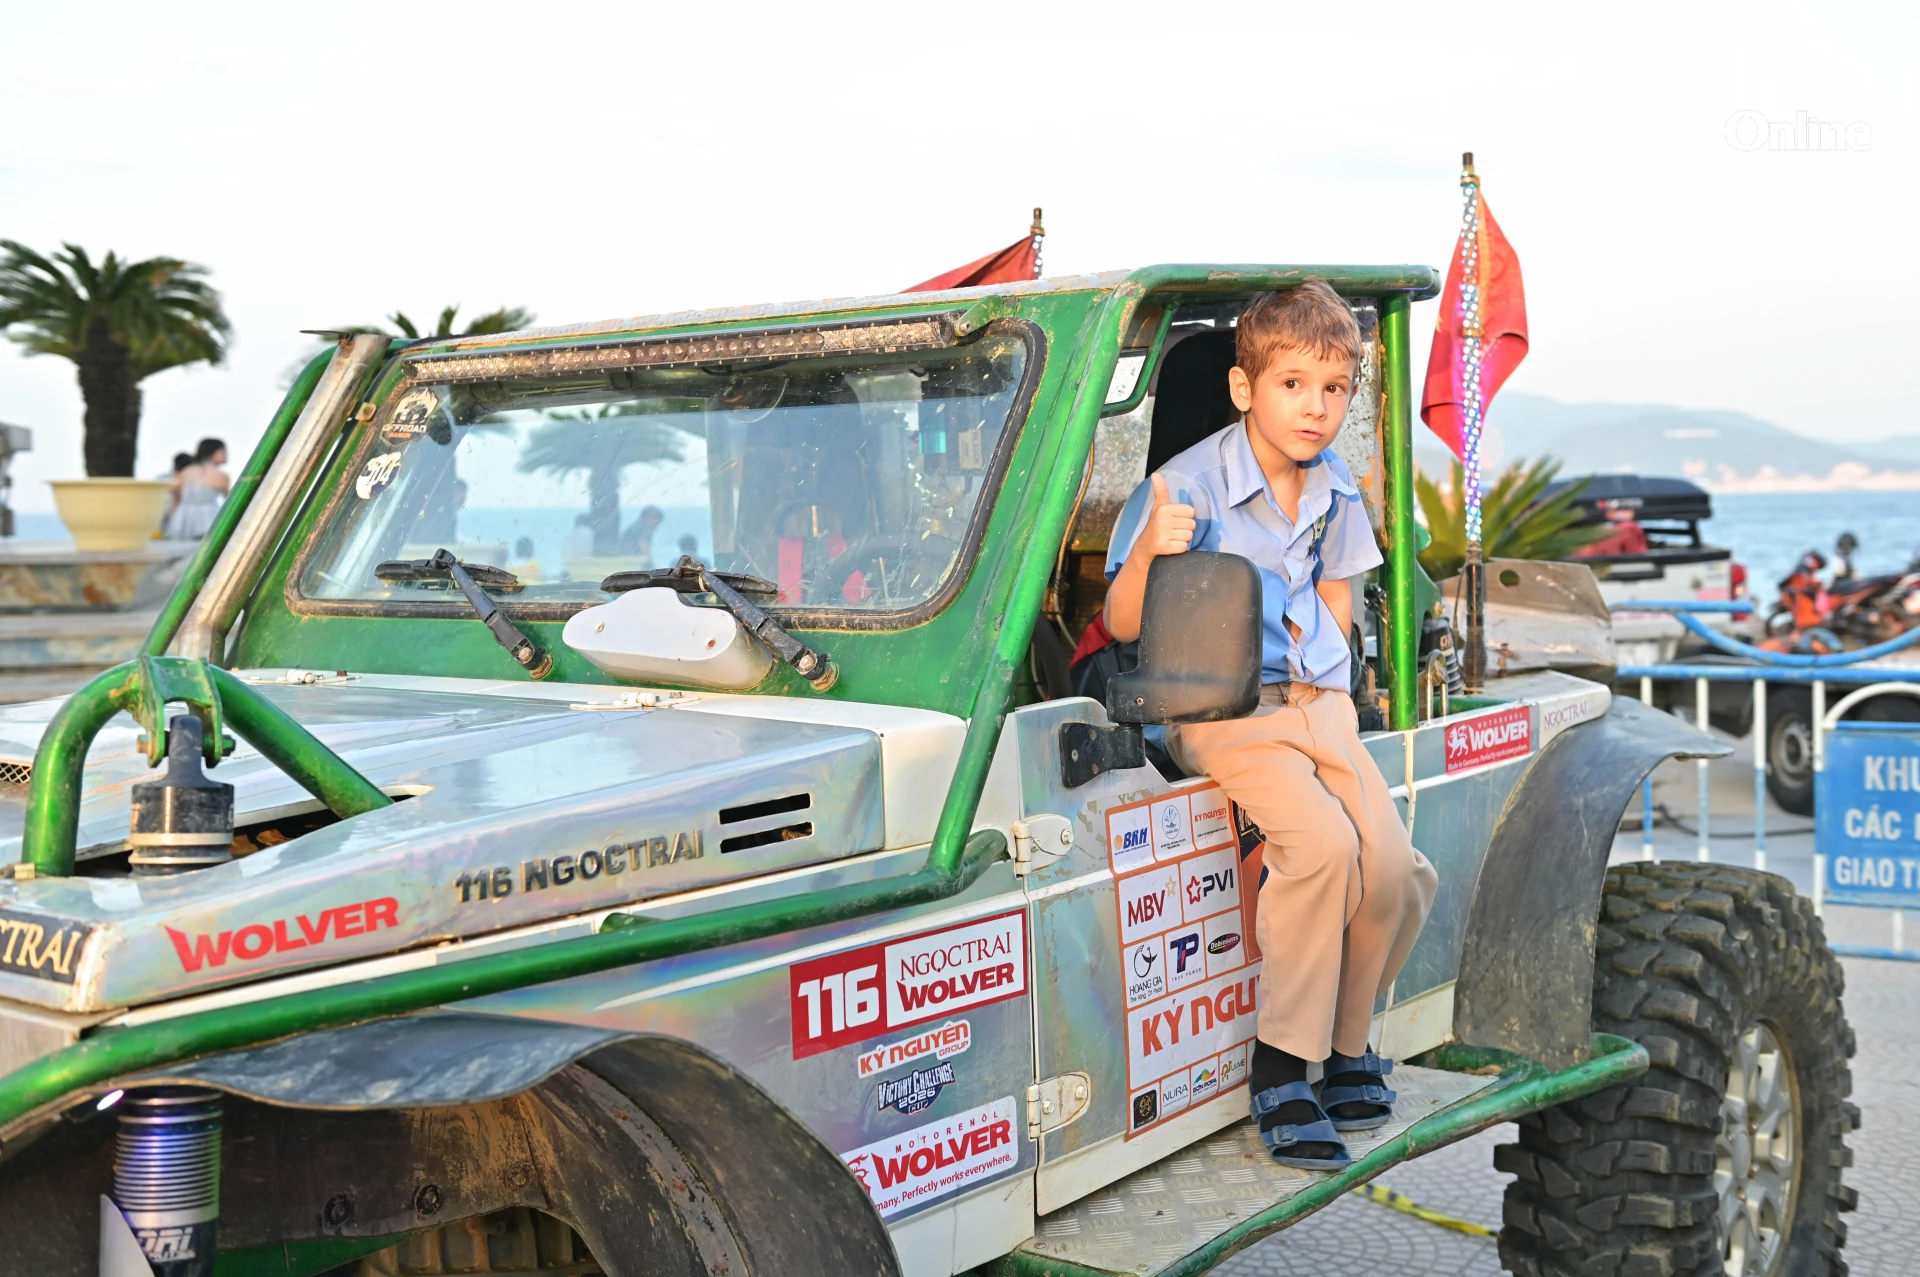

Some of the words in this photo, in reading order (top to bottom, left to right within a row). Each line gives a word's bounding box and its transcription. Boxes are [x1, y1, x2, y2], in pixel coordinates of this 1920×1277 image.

[1467, 719, 1529, 752] WOLVER
[1845, 804, 1902, 840] CÁC
[451, 866, 512, 902] 116
[520, 829, 704, 893] NGOCTRAI
[1202, 868, 1234, 898] PVI
[1835, 856, 1895, 888] GIAO
[1901, 860, 1920, 889] T
[1127, 890, 1166, 927] MBV
[0, 918, 82, 975] TRAI
[164, 897, 399, 973] WOLVER
[798, 963, 880, 1039] 116
[896, 962, 1015, 1012] WOLVER
[1190, 974, 1261, 1037] NGU
[938, 1040, 969, 1057] GROUP
[908, 1100, 929, 1115] CUP
[1162, 1083, 1188, 1103] NURA
[870, 1119, 1011, 1190] WOLVER
[902, 1180, 939, 1202] Perfectly
[939, 1172, 963, 1187] works
[964, 1154, 1012, 1177] everywhere.
